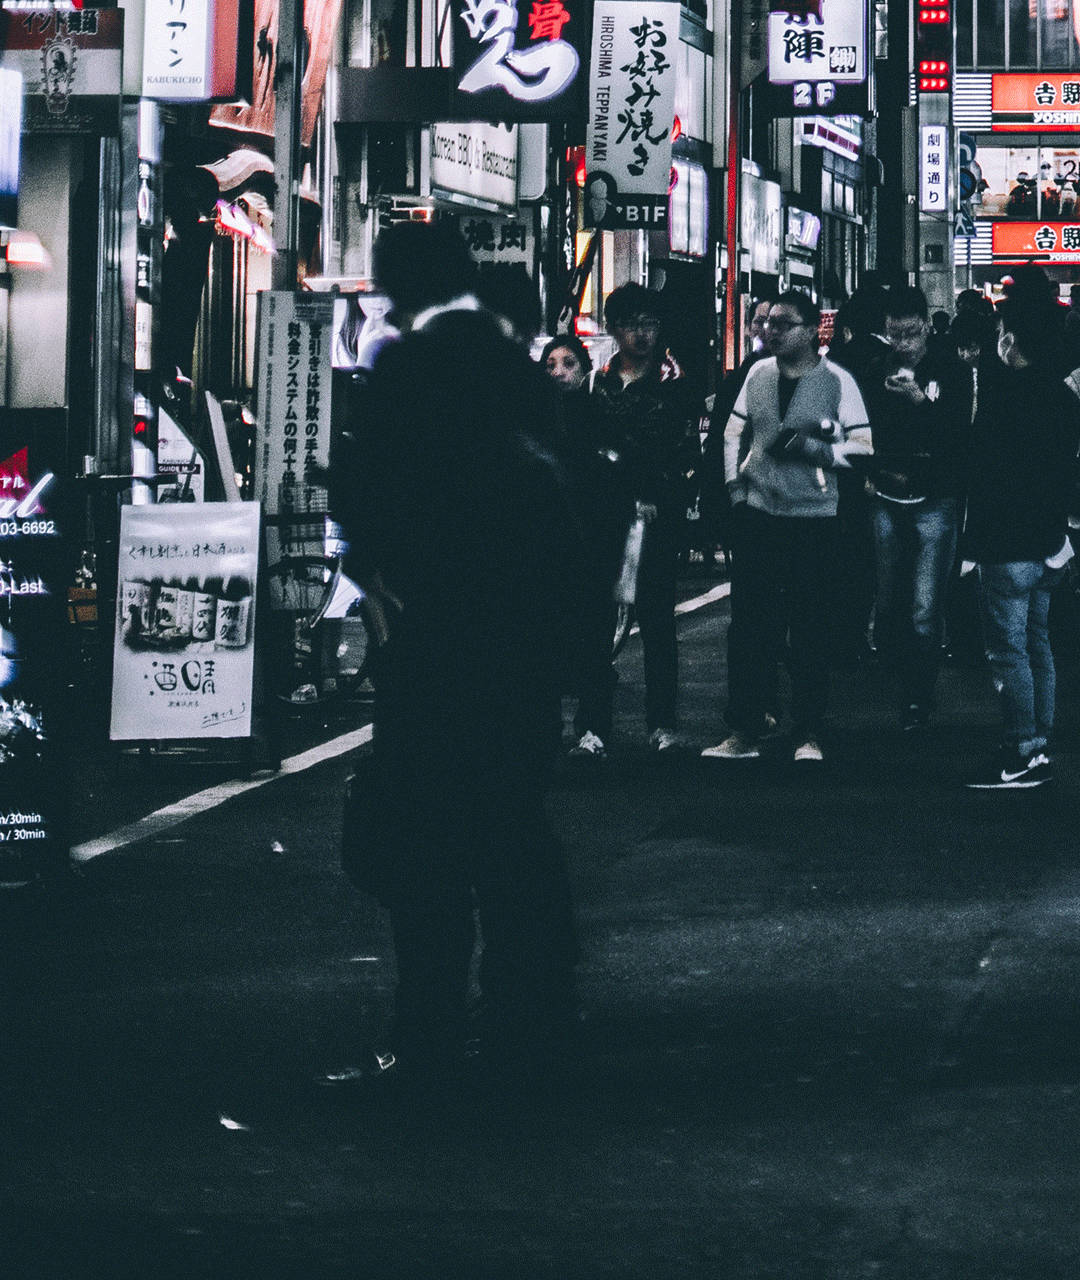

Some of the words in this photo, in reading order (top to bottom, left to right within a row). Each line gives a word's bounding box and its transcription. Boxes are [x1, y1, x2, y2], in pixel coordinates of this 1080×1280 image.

[597, 15, 615, 78] HIROSHIMA
[592, 85, 610, 161] TEPPANYAKI
[615, 16, 671, 176] お好み焼き
[793, 82, 835, 107] 2F
[926, 134, 941, 204] 劇場通り
[624, 204, 666, 223] B1F
